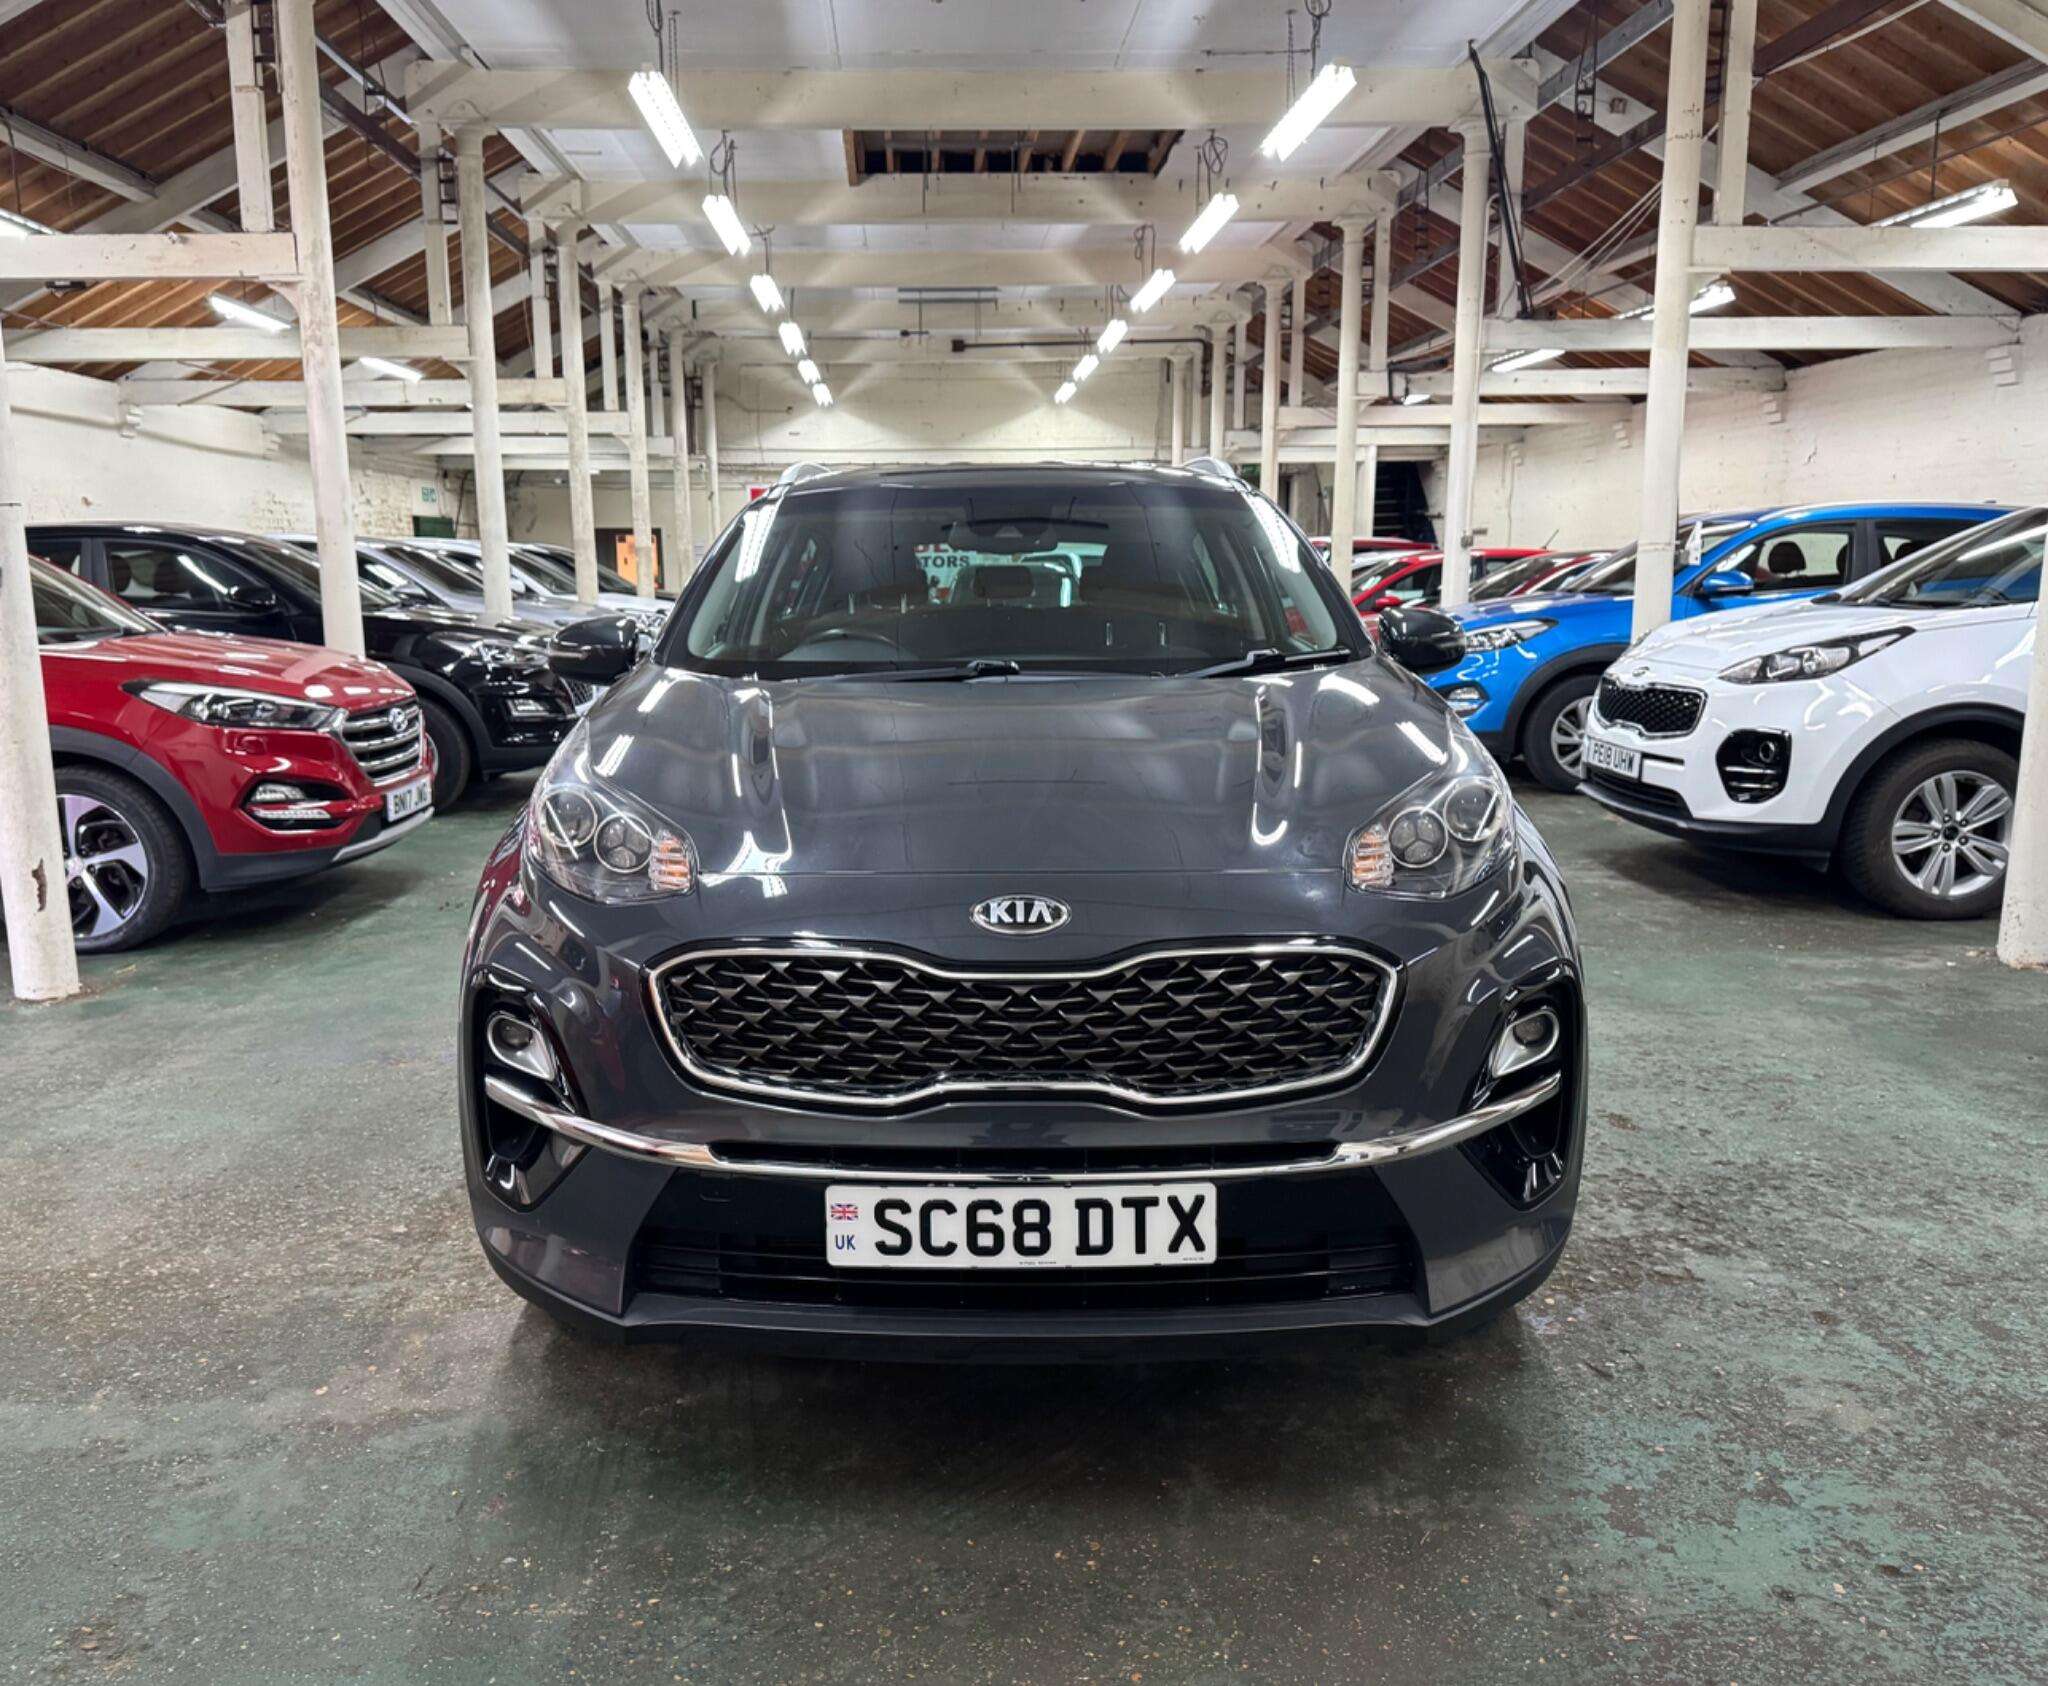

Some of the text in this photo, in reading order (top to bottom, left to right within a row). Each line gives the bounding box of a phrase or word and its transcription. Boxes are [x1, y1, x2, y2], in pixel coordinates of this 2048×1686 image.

[917, 555, 970, 568] TORS
[990, 900, 1053, 923] KIA
[874, 1194, 1206, 1257] SC68 DTX
[835, 1234, 856, 1250] UK
